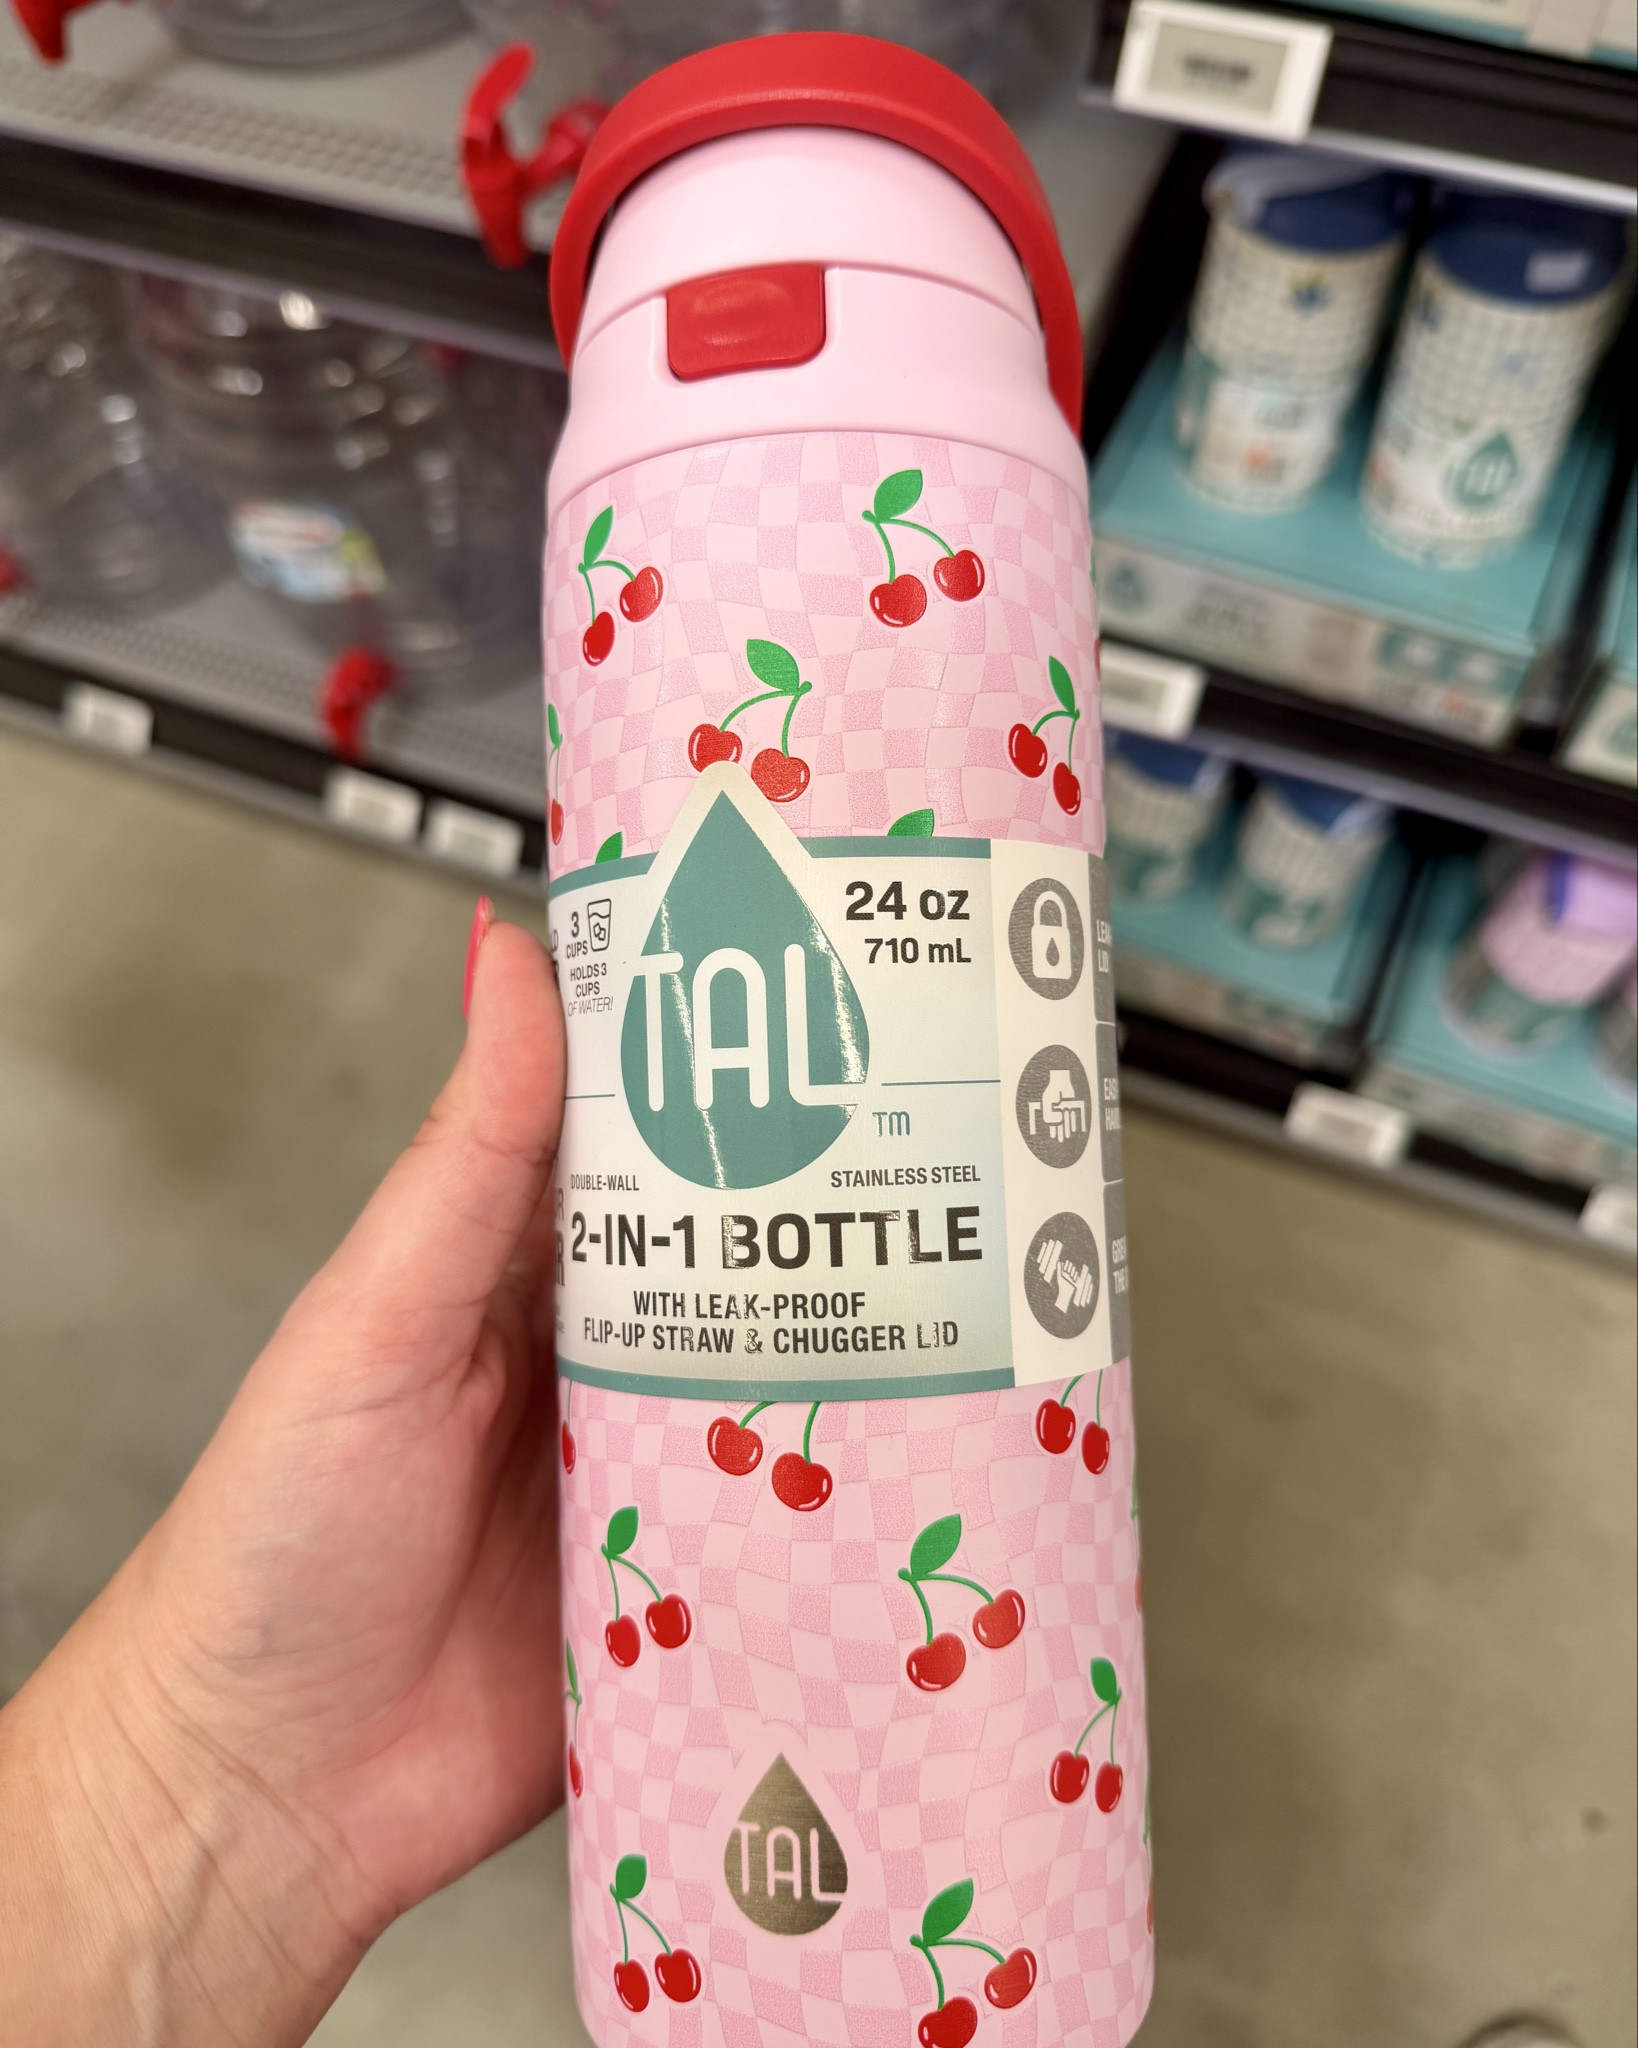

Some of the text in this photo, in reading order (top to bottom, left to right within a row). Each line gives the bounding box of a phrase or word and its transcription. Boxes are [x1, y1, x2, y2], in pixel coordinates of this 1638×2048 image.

[845, 881, 969, 920] 24 oz
[571, 911, 579, 938] 3
[566, 940, 588, 959] CUPS
[864, 938, 971, 964] 710 mL
[570, 962, 607, 981] HOLDS 3
[575, 981, 600, 998] CUPS
[567, 996, 614, 1016] OF WATER!
[627, 943, 862, 1112] TAL
[570, 1174, 640, 1191] DOUBLE-WALL
[830, 1165, 981, 1188] STAINLESS STEEL
[571, 1211, 696, 1269] 2-IN-1
[721, 1206, 983, 1270] BOTTLE
[633, 1290, 866, 1319] WITH LEAK-PROOF
[584, 1317, 645, 1347] FLIP-UP
[652, 1324, 735, 1353] STRAW
[744, 1328, 763, 1354] &
[773, 1325, 906, 1354] CHUGGER
[916, 1321, 958, 1348] LID
[734, 1820, 851, 1902] TAL
